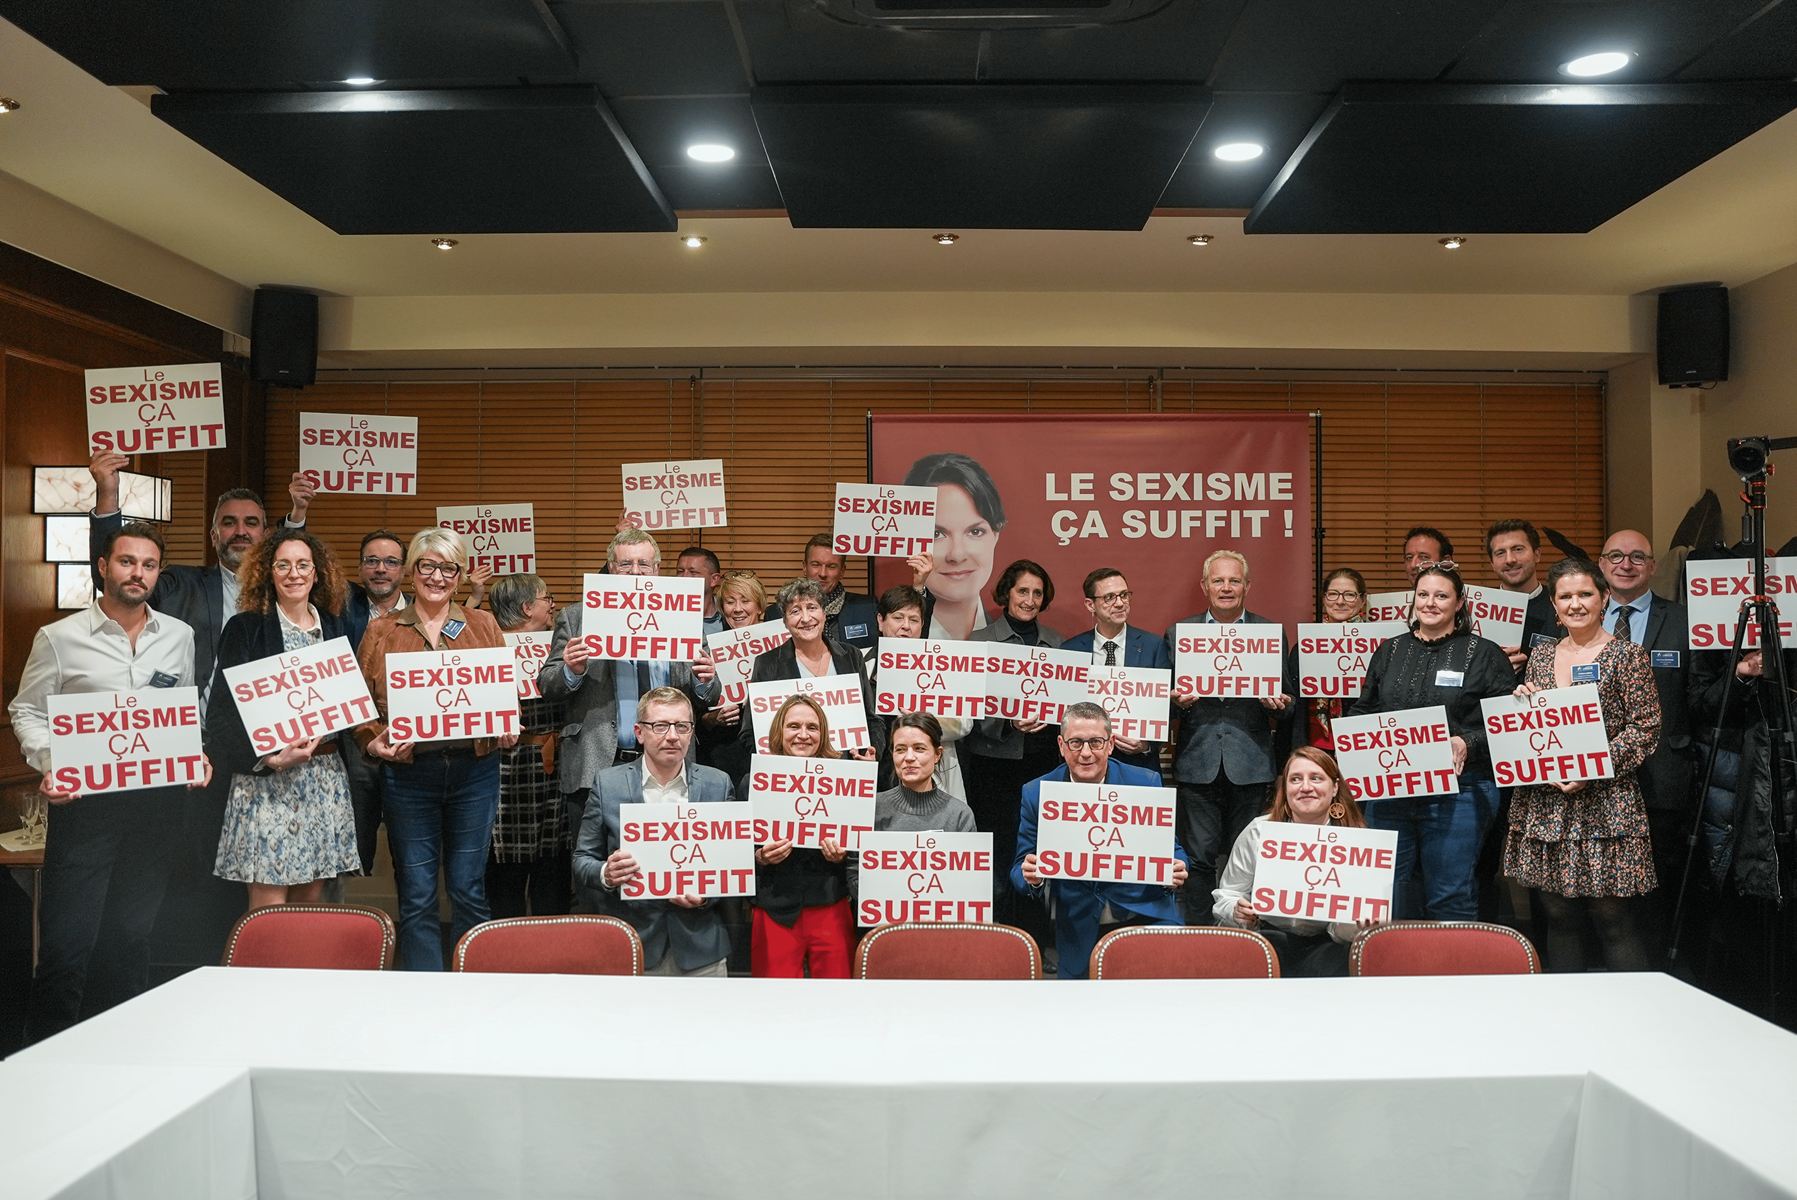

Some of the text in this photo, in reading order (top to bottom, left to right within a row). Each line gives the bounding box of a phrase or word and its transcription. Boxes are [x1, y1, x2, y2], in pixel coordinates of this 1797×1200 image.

[144, 369, 164, 382] Le
[89, 380, 220, 404] SEXISME
[138, 402, 176, 427] ÇA
[350, 416, 368, 430] Le
[91, 424, 224, 452] SUFFIT
[302, 428, 415, 449] SEXISME
[342, 448, 375, 470] ÇA
[664, 464, 680, 474] Le
[303, 469, 415, 493] SUFFIT
[625, 472, 722, 491] SEXISME
[880, 486, 895, 498] Le
[1046, 472, 1294, 501] LE SEXISME
[660, 490, 689, 509] ÇA
[838, 498, 935, 516] SEXISME
[477, 507, 492, 518] Le
[627, 507, 724, 529] SUFFIT
[871, 516, 898, 536] ÇA
[1050, 510, 1294, 546] ÇA SUFFIT !
[472, 536, 500, 555] ÇA
[834, 534, 933, 556] SUFFIT
[636, 578, 654, 591] Le
[1466, 587, 1482, 600] Le
[1690, 575, 1797, 596] SEXS
[586, 590, 702, 612] SEXISME
[1468, 600, 1524, 624] ISME
[626, 612, 660, 635] ÇA
[1220, 626, 1237, 637] Le
[1342, 626, 1359, 636] Le
[1472, 620, 1482, 637] A
[516, 634, 533, 644] Le
[584, 634, 700, 660] SUFFIT
[734, 631, 751, 642] Le
[924, 641, 941, 654] Le
[1178, 638, 1280, 654] SEXISME
[279, 654, 300, 670] Le
[442, 652, 460, 666] Le
[880, 652, 984, 672] SEXISME
[1030, 649, 1048, 662] Le
[1214, 654, 1244, 675] ÇA
[1338, 656, 1367, 676] ÇA
[234, 653, 357, 702] SEXISME
[390, 664, 514, 689] SEXISME
[737, 660, 752, 680] Ç
[986, 656, 1088, 684] SEXISME
[1110, 668, 1126, 680] Le
[796, 681, 813, 692] Le
[916, 672, 946, 693] ÇA
[1020, 678, 1049, 698] ÇA
[1177, 675, 1280, 696] SUFFIT
[1302, 676, 1366, 696] SUF
[114, 694, 137, 708] Le
[286, 686, 324, 714] ÇA
[435, 688, 472, 712] ÇA
[753, 688, 862, 713] SESME
[878, 692, 984, 717] SUFFIT
[984, 696, 1072, 723] SUFFI
[1529, 695, 1547, 710] Le
[52, 706, 198, 736] SEXISME
[252, 695, 372, 752] SUFFIT
[391, 710, 518, 741] SUFFIT
[1378, 716, 1396, 728] Le
[1487, 703, 1600, 735] SEXISME
[108, 732, 150, 760] ÇA
[1336, 724, 1448, 752] SEXISME
[1529, 730, 1564, 756] ÇA
[804, 760, 824, 774] Le
[1378, 749, 1410, 773] ÇA
[1495, 752, 1609, 785] SUFFIT
[55, 754, 201, 794] SUFFIT
[752, 772, 874, 798] SEXISME
[1344, 769, 1454, 800] SUFFIT
[1098, 786, 1118, 802] Le
[677, 805, 698, 820] Le
[794, 796, 828, 820] ÇA
[1042, 800, 1173, 827] SEXISME
[624, 820, 751, 842] SEXISME
[753, 818, 872, 848] SUFFIT
[916, 834, 936, 850] Le
[1088, 826, 1125, 852] ÇA
[1317, 828, 1338, 842] Le
[670, 844, 706, 870] ÇA
[862, 850, 990, 872] SEXISME
[1260, 840, 1393, 869] SEXISME
[1038, 850, 1173, 882] SUFFIT
[623, 868, 753, 897] SUFFIT
[907, 873, 944, 898] ÇA
[1304, 866, 1341, 890] ÇA
[860, 900, 991, 924] SUFFIT
[1252, 888, 1390, 922] SUFFIT
